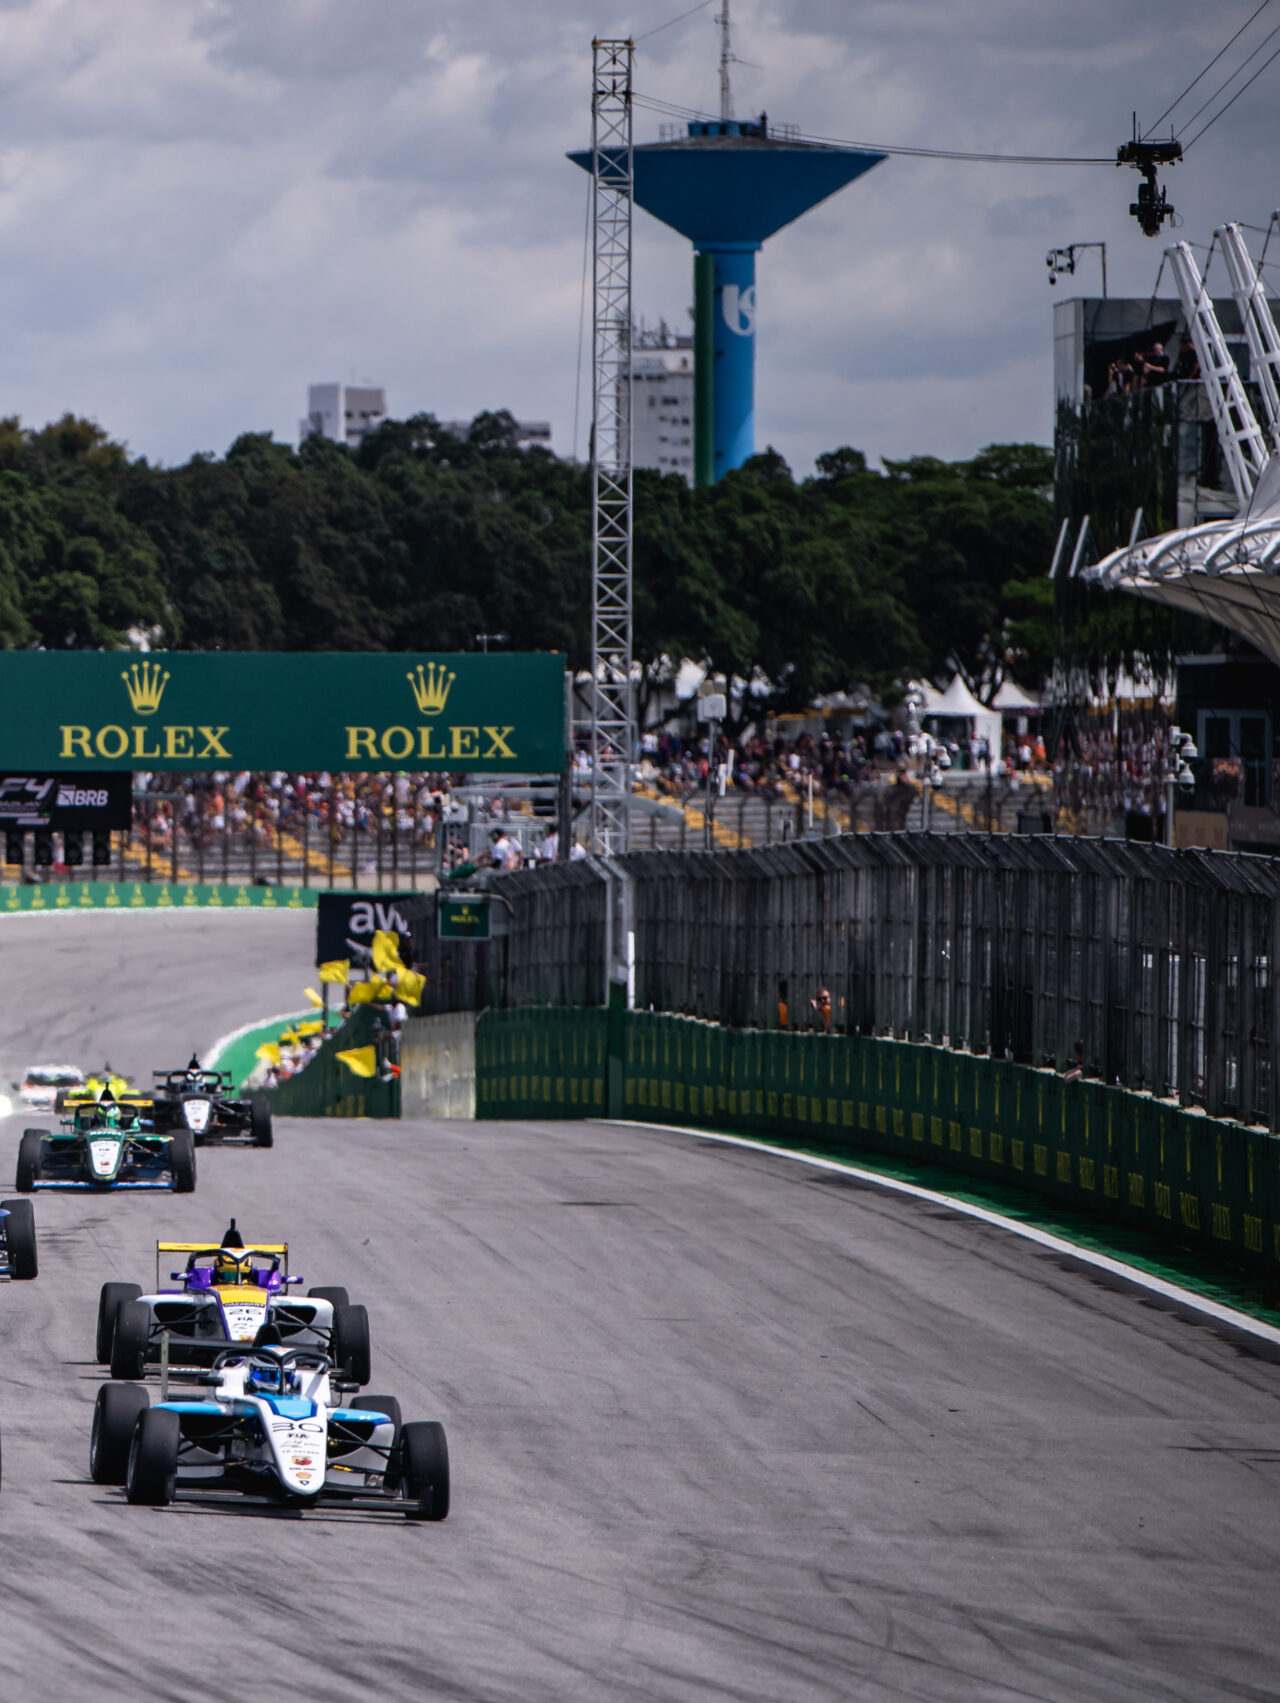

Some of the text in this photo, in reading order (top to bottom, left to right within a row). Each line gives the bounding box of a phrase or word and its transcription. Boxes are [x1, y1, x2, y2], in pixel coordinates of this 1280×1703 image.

[59, 724, 232, 759] ROLEX
[345, 725, 517, 759] ROLEX
[75, 790, 108, 806] BRB
[272, 1423, 324, 1433] 30
